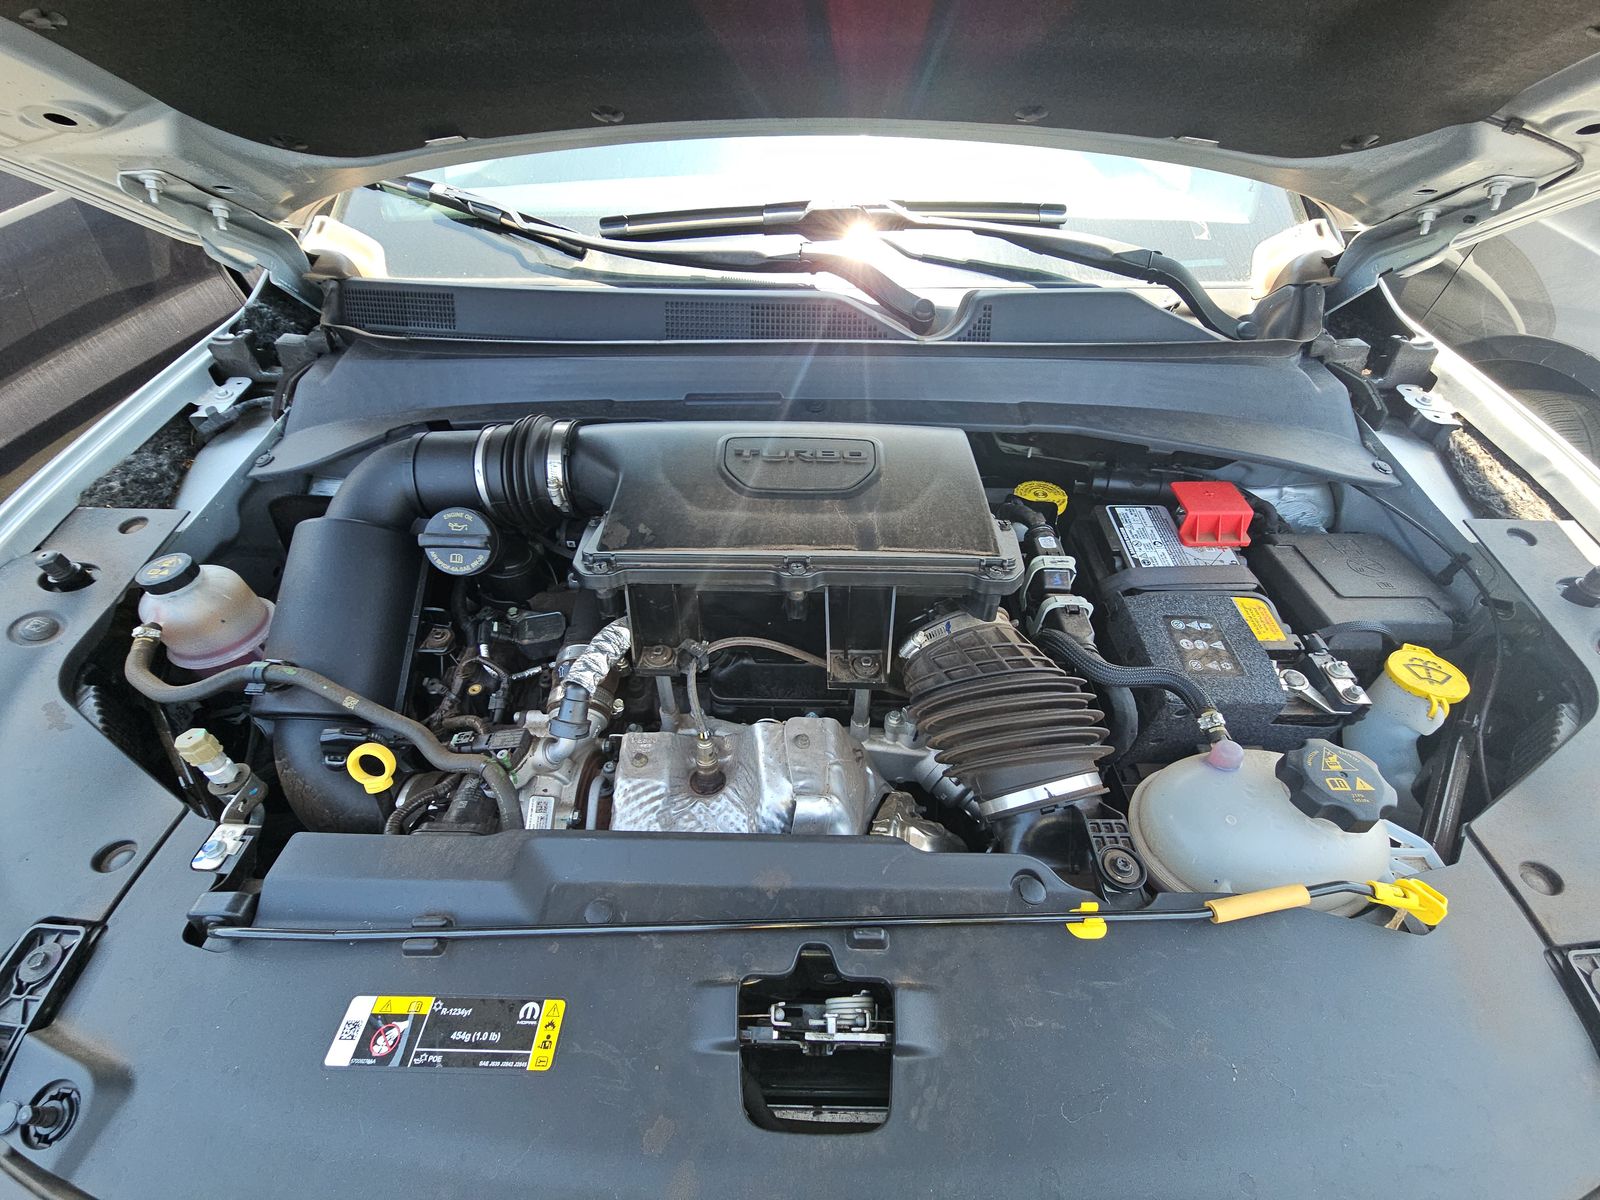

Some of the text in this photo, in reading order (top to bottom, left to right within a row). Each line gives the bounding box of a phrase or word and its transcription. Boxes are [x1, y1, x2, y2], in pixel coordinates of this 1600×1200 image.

[735, 448, 867, 463] TURBO
[444, 512, 473, 522] ENGINE OIL
[440, 1008, 472, 1018] R-1234yf
[451, 1031, 501, 1042] 454g (1.0 lb)
[428, 1055, 443, 1063] POE
